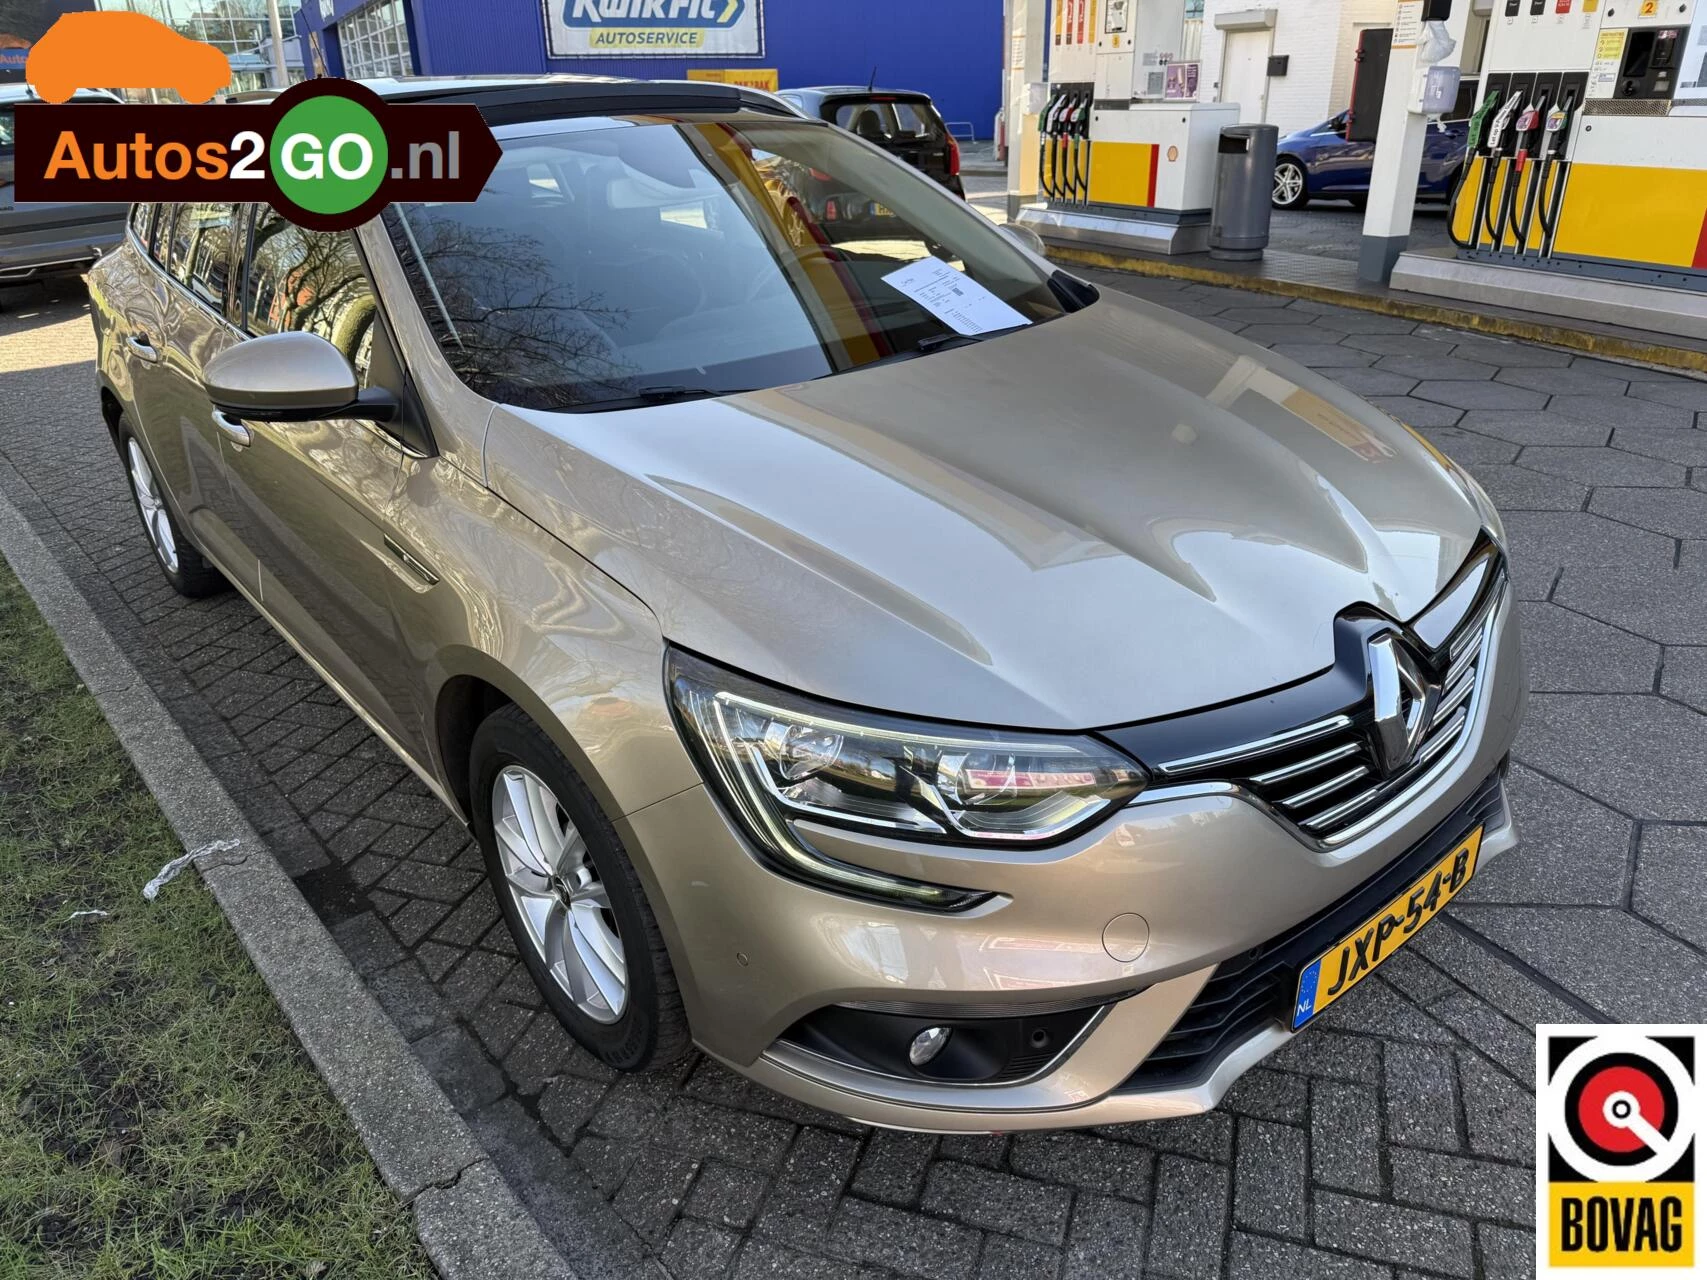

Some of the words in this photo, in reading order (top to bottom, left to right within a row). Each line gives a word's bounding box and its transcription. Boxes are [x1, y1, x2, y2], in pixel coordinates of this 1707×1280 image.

[1645, 2, 1653, 14] 2
[595, 32, 698, 45] AUTOSERVICE
[1327, 848, 1469, 995] JXP-54-B
[1297, 1000, 1312, 1017] NL
